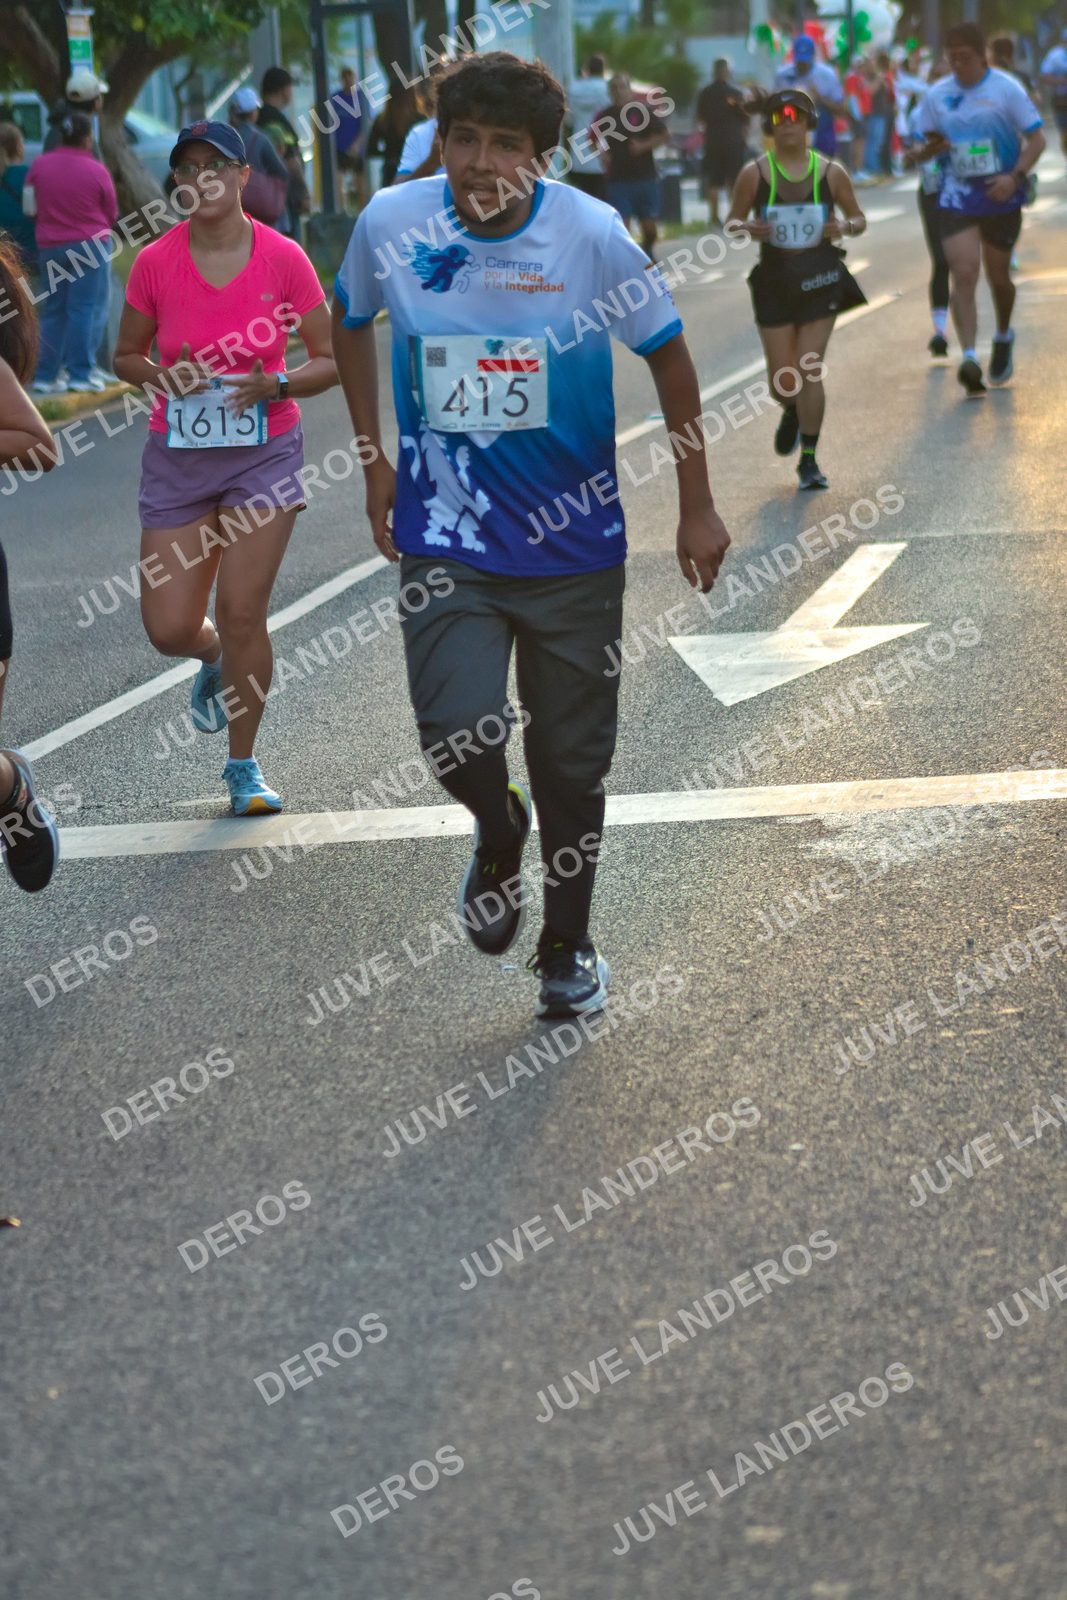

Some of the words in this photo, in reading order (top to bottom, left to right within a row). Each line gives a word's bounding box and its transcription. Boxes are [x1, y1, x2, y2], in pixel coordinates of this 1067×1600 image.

[775, 223, 815, 242] 819
[485, 256, 543, 272] Carrera
[485, 271, 502, 280] por
[506, 271, 515, 281] la
[518, 272, 545, 283] Vida
[505, 282, 565, 294] Integridad
[441, 376, 529, 417] 415
[174, 403, 256, 438] 1615
